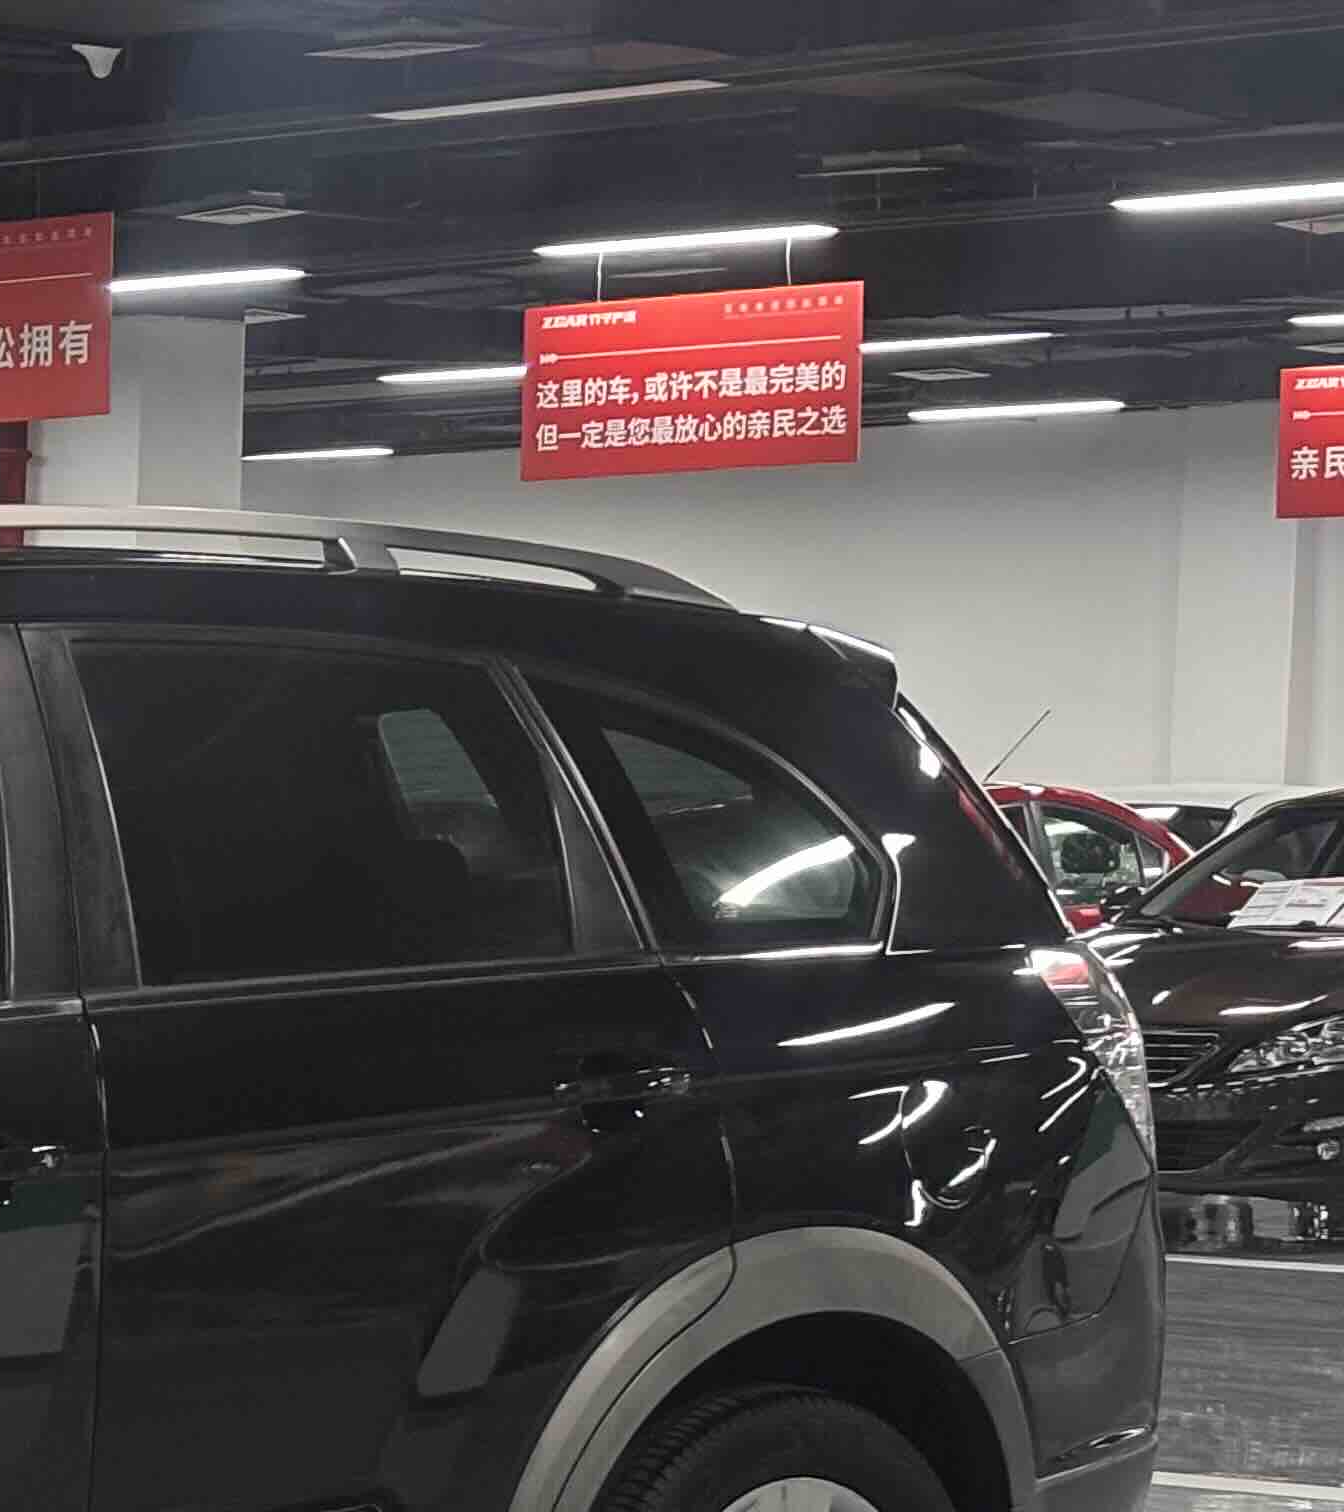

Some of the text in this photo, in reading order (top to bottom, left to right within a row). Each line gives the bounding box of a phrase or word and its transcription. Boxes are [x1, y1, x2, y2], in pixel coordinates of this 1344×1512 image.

[535, 404, 848, 452] 但一定是您最放心的亲民之选
